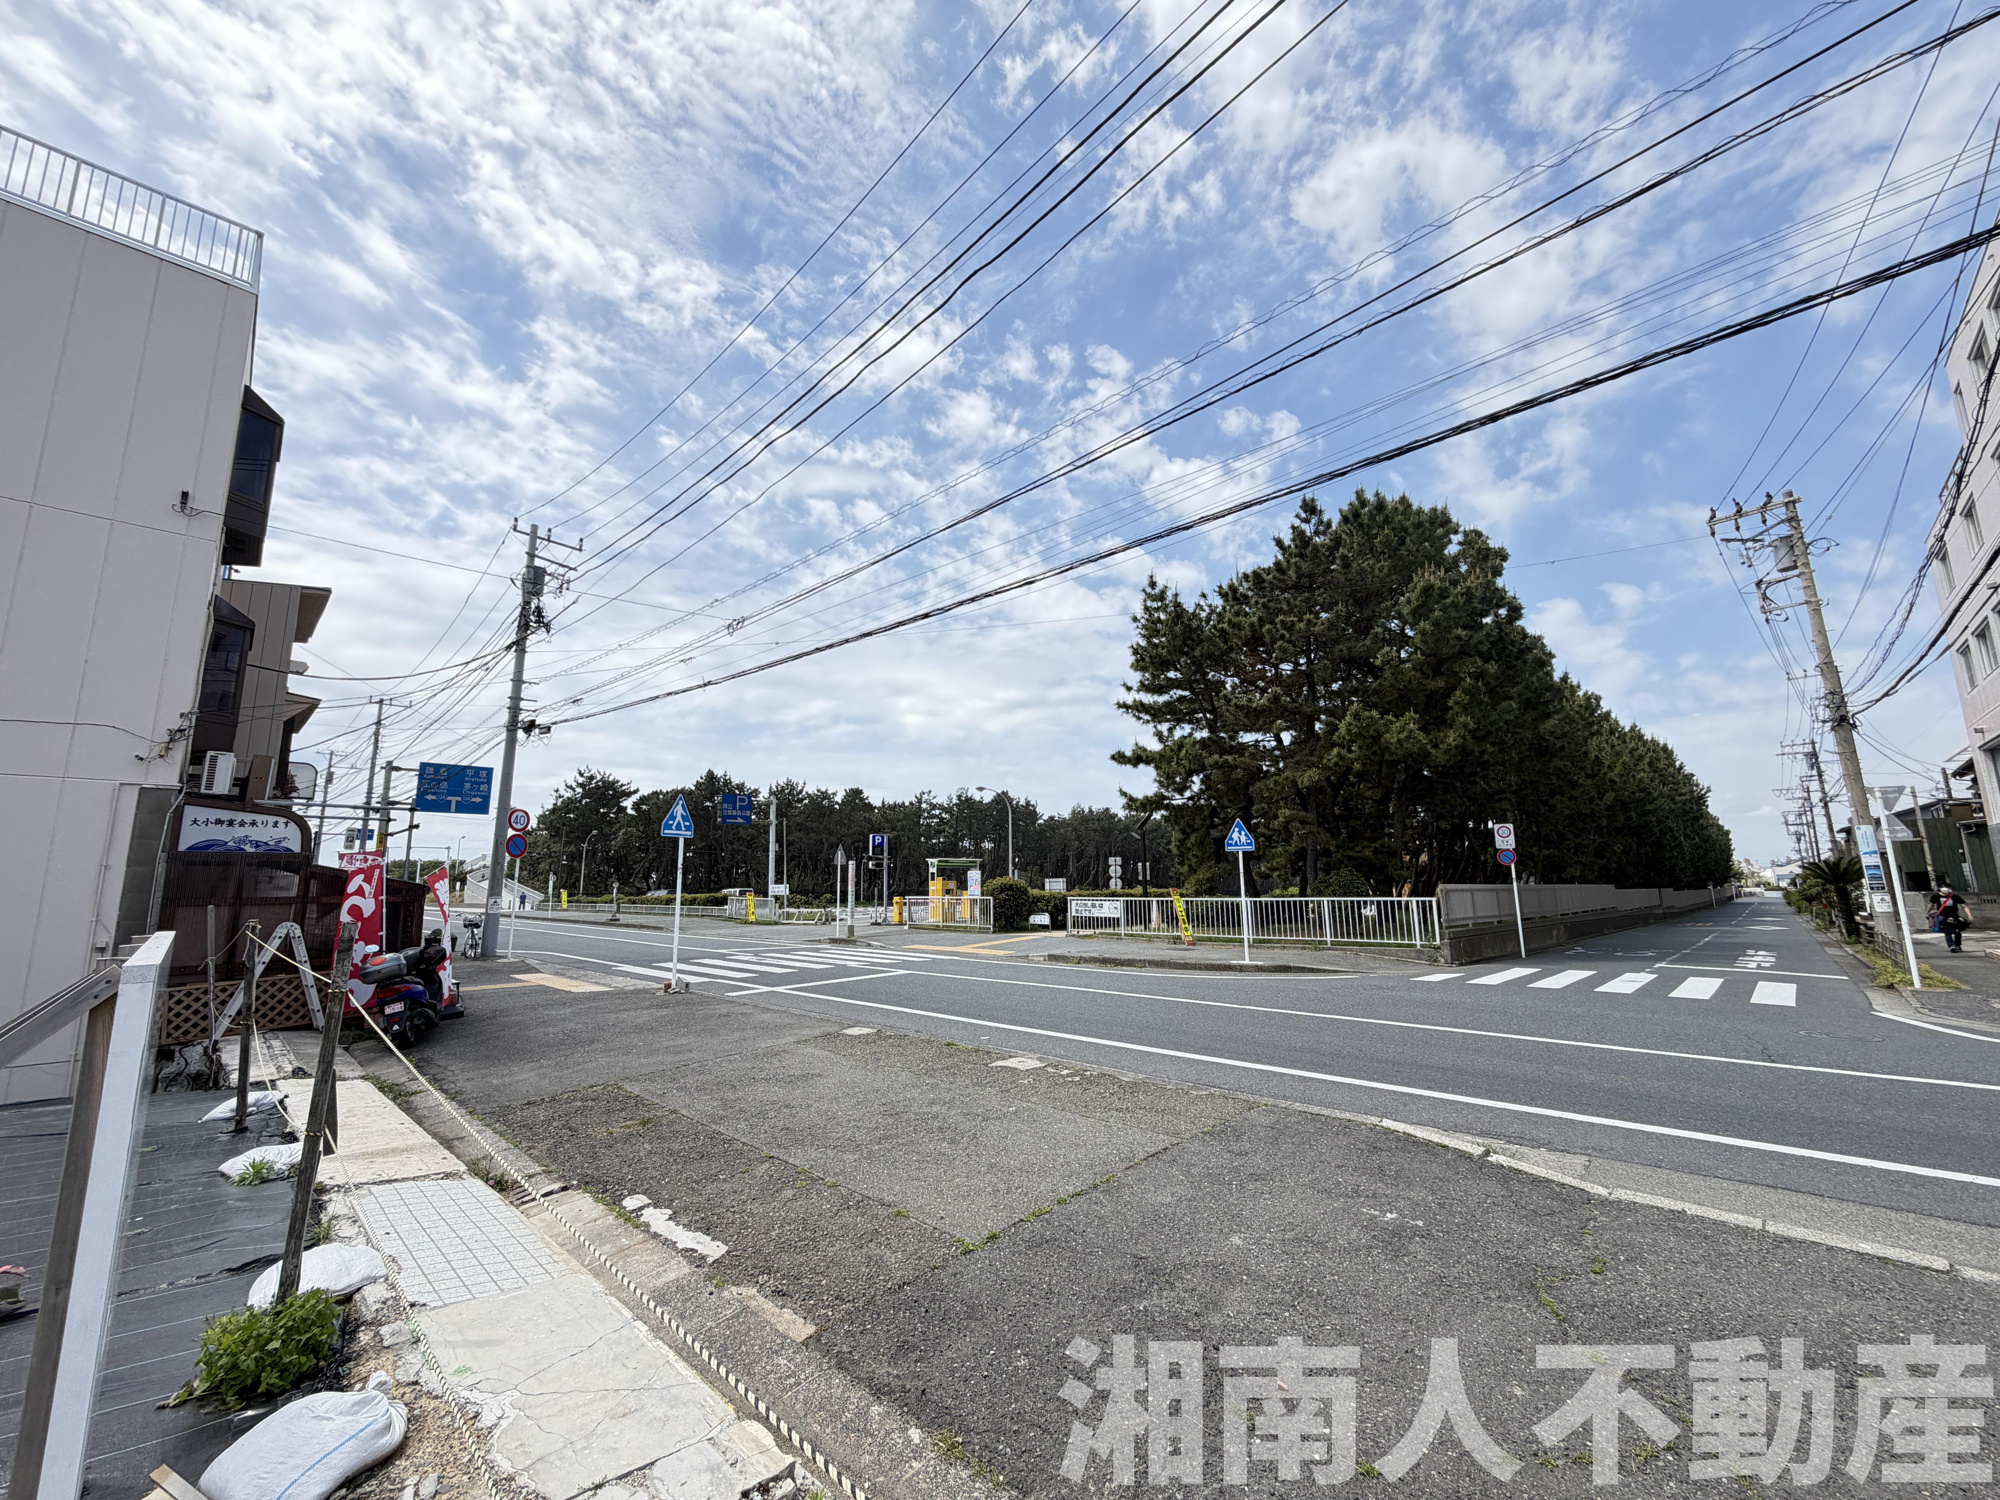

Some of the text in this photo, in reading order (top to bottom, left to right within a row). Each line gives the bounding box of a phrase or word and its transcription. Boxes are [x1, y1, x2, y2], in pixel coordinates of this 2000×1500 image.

[466, 769, 488, 777] 平塚
[736, 795, 749, 810] P
[189, 817, 292, 829] 大小御宴会承ります
[512, 814, 526, 826] 40
[875, 836, 882, 846] P
